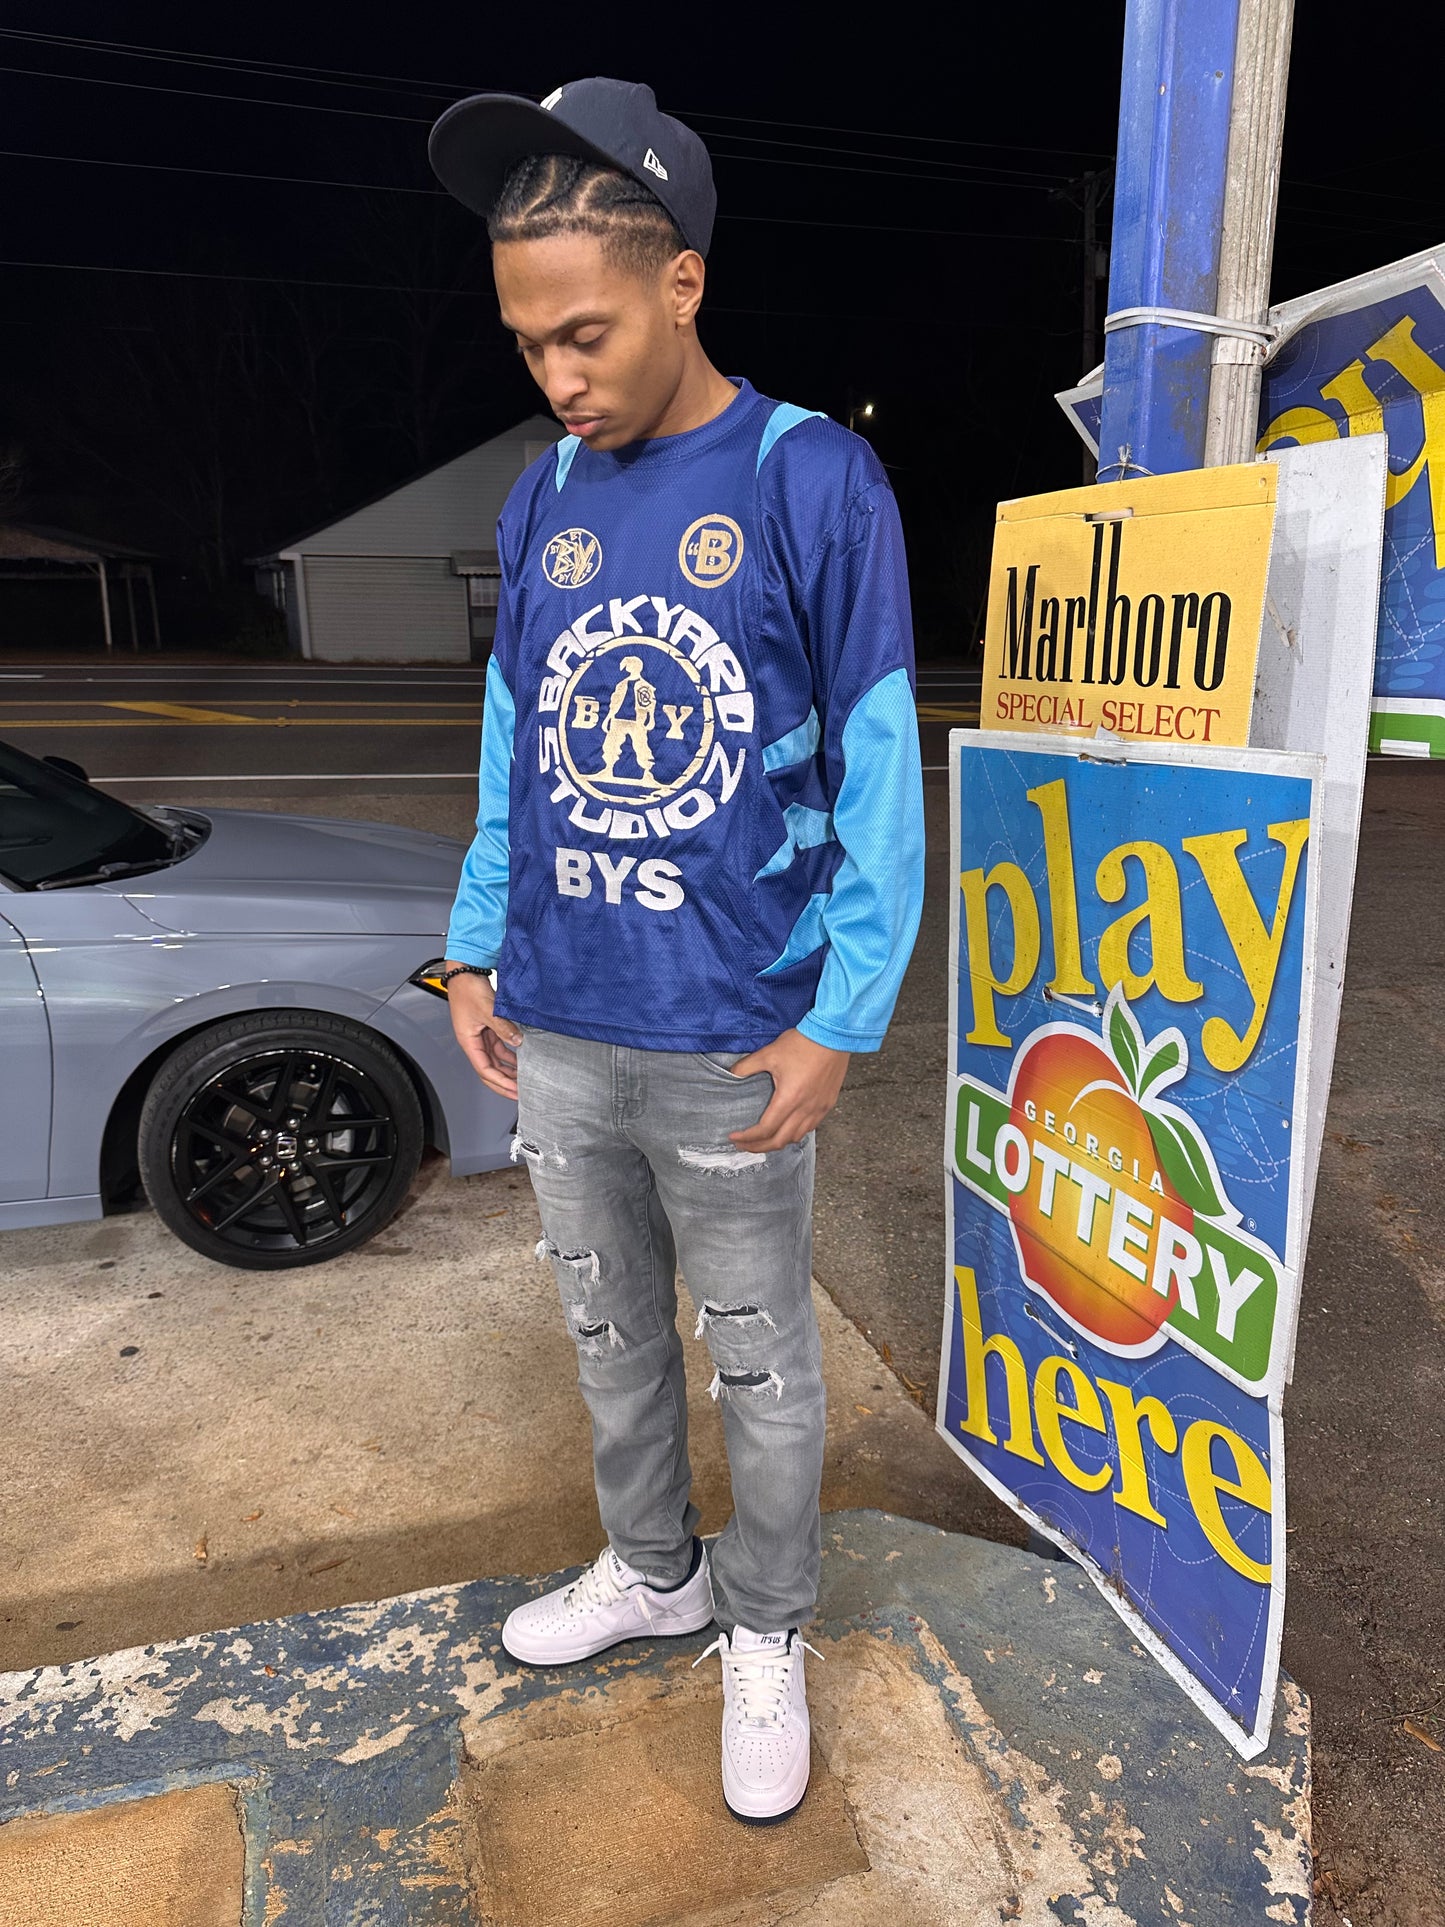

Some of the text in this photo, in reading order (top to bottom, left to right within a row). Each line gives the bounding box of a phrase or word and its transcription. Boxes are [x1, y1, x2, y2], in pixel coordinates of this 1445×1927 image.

[538, 594, 754, 733] BACKYARD
[999, 521, 1232, 691] Marlboro
[996, 691, 1221, 742] SPECIAL SELECT
[555, 846, 685, 911] BYS
[960, 778, 1309, 1072] play
[1024, 1099, 1165, 1197] GEORGIA
[965, 1101, 1265, 1343] LOTTERY
[954, 1265, 1273, 1586] here
[772, 1635, 782, 1645] US
